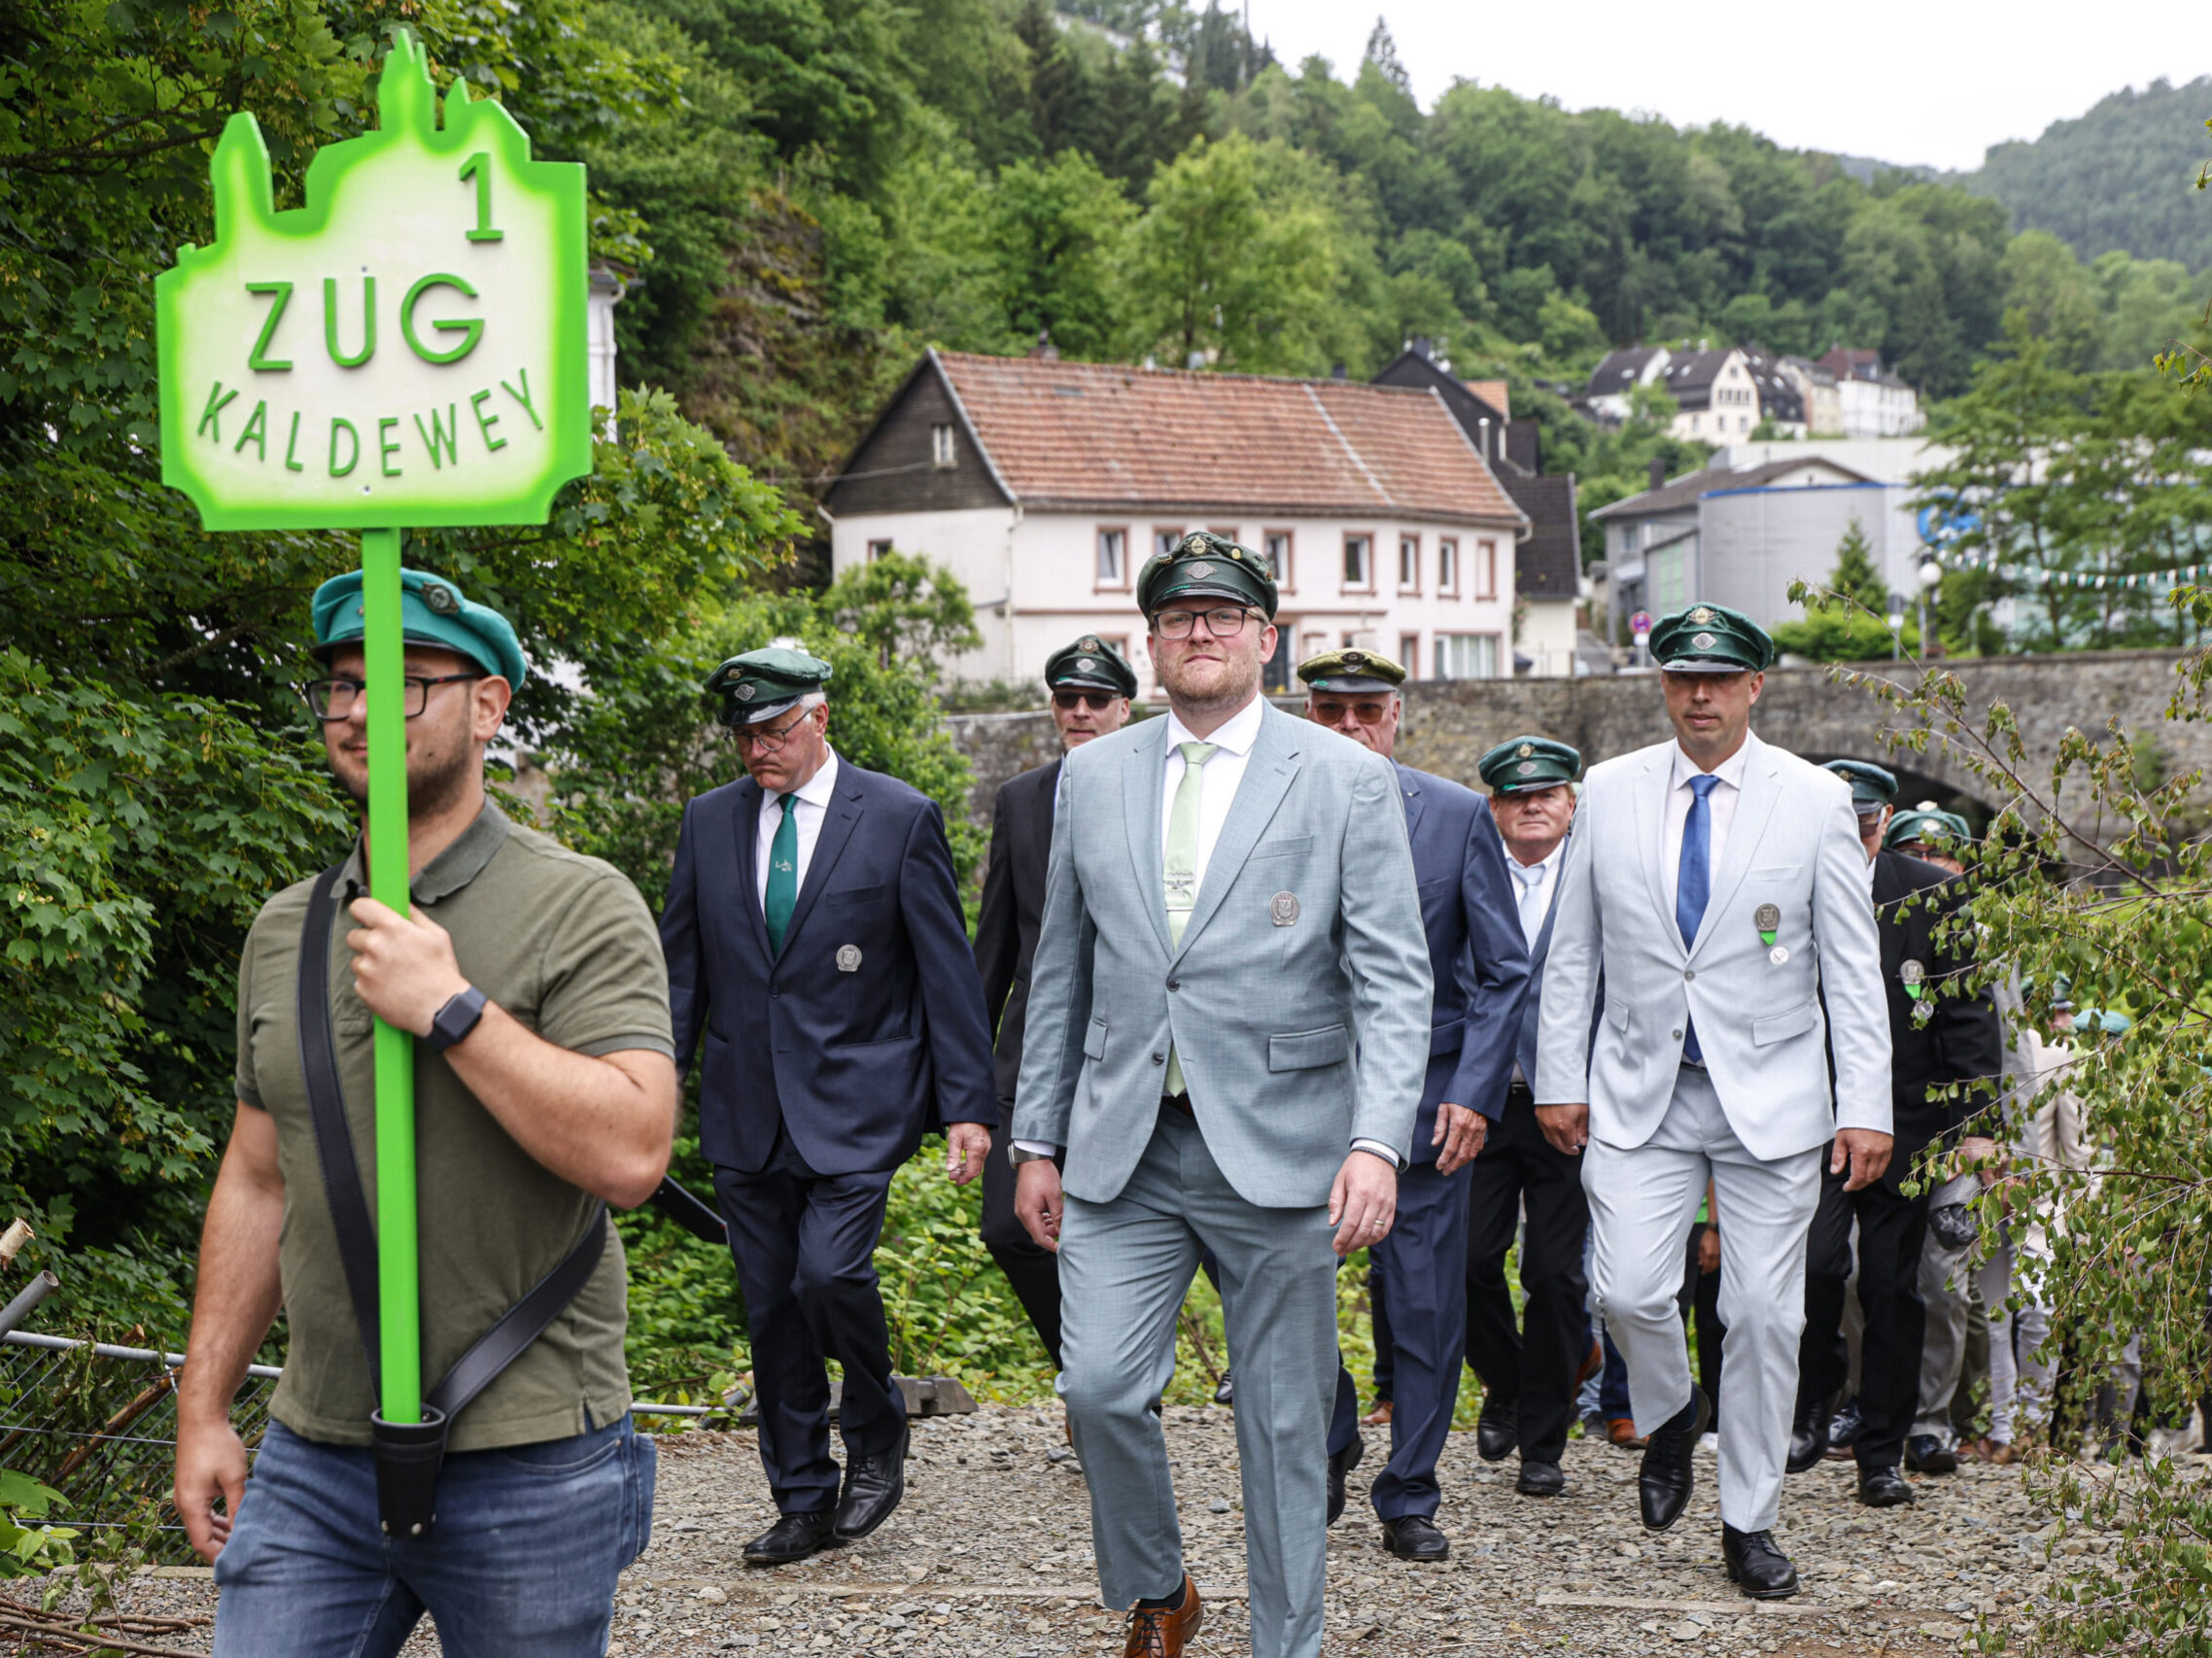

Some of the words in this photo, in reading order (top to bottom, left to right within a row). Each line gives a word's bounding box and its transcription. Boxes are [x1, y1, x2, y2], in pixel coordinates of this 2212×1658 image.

[459, 152, 503, 244] 1
[245, 272, 485, 372] ZUG
[196, 367, 544, 477] KALDEWEY
